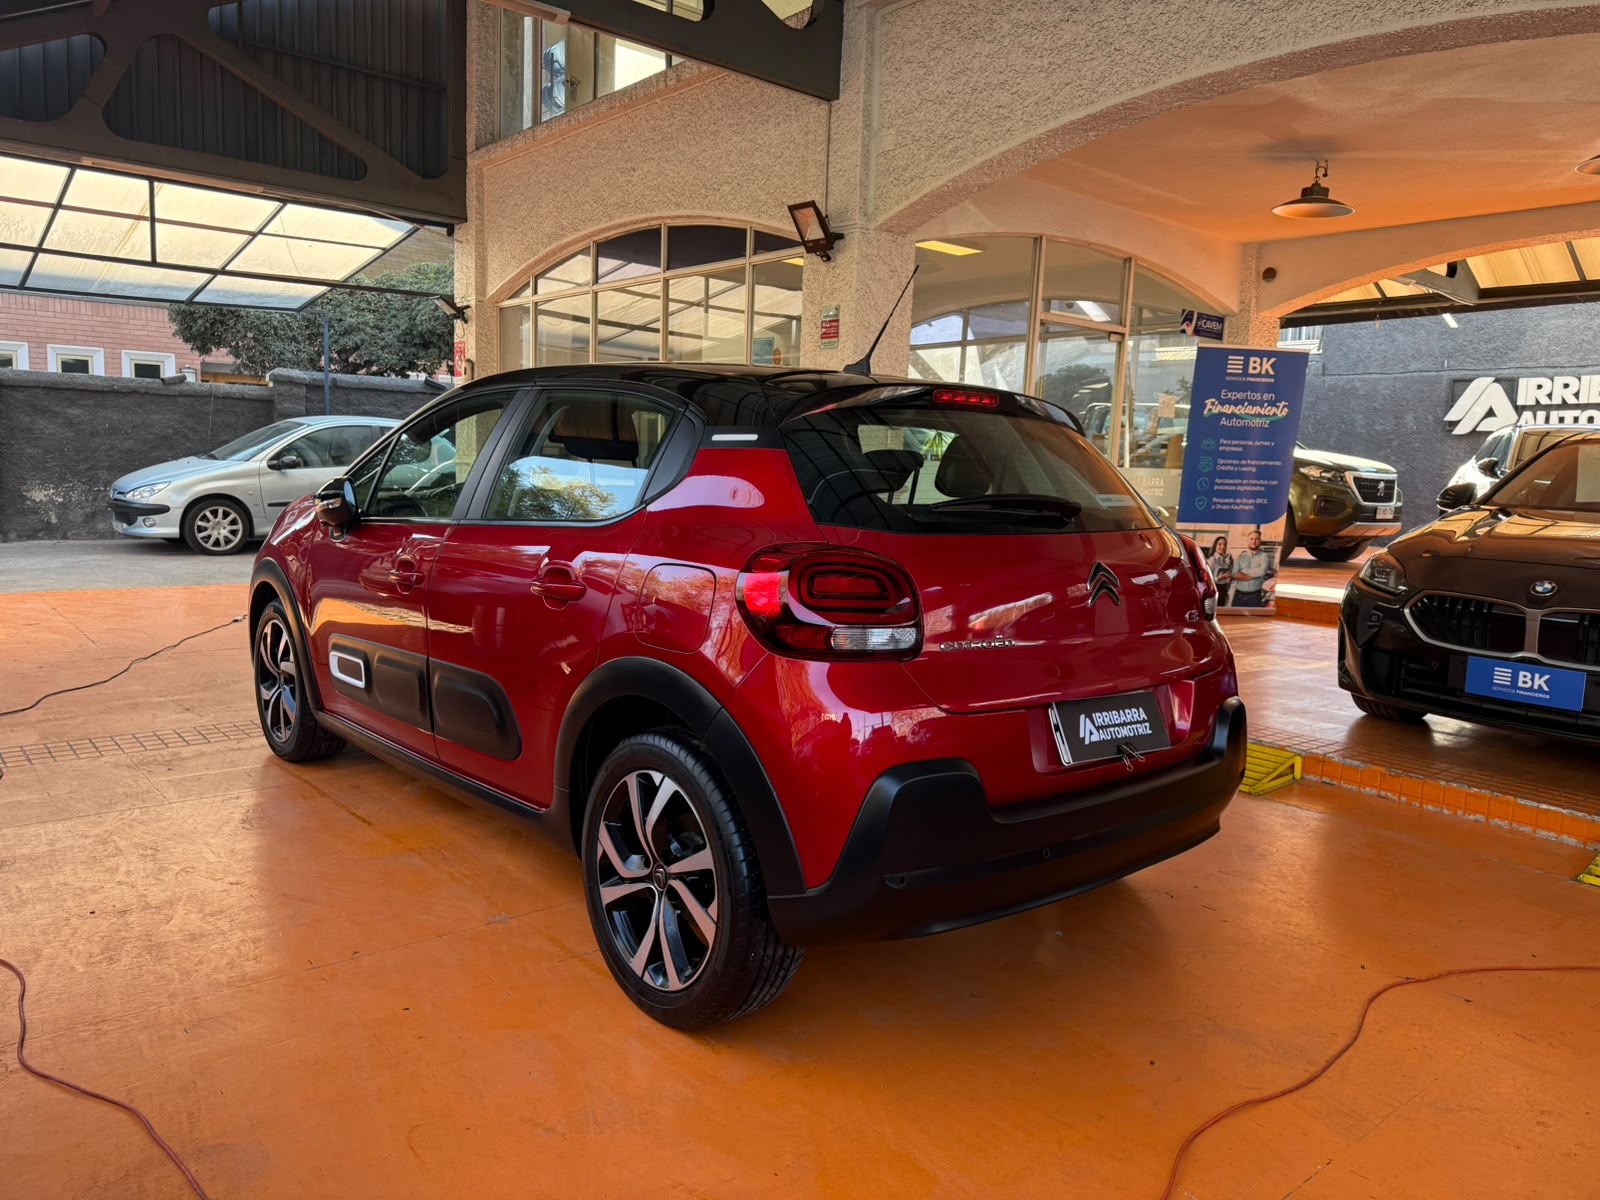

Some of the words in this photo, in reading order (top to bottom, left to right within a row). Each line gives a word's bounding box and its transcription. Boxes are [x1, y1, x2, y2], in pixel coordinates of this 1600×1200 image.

[1248, 356, 1277, 375] BK
[1221, 389, 1261, 401] Expertos
[1263, 392, 1275, 401] en
[1203, 398, 1289, 417] Financiamiento
[1219, 416, 1270, 428] Automotriz
[1517, 670, 1551, 692] BK
[1516, 689, 1550, 700] FINANCIEROS
[1092, 706, 1148, 727] IRRIBARRA
[1099, 722, 1153, 741] AUTOMOTRIZ
